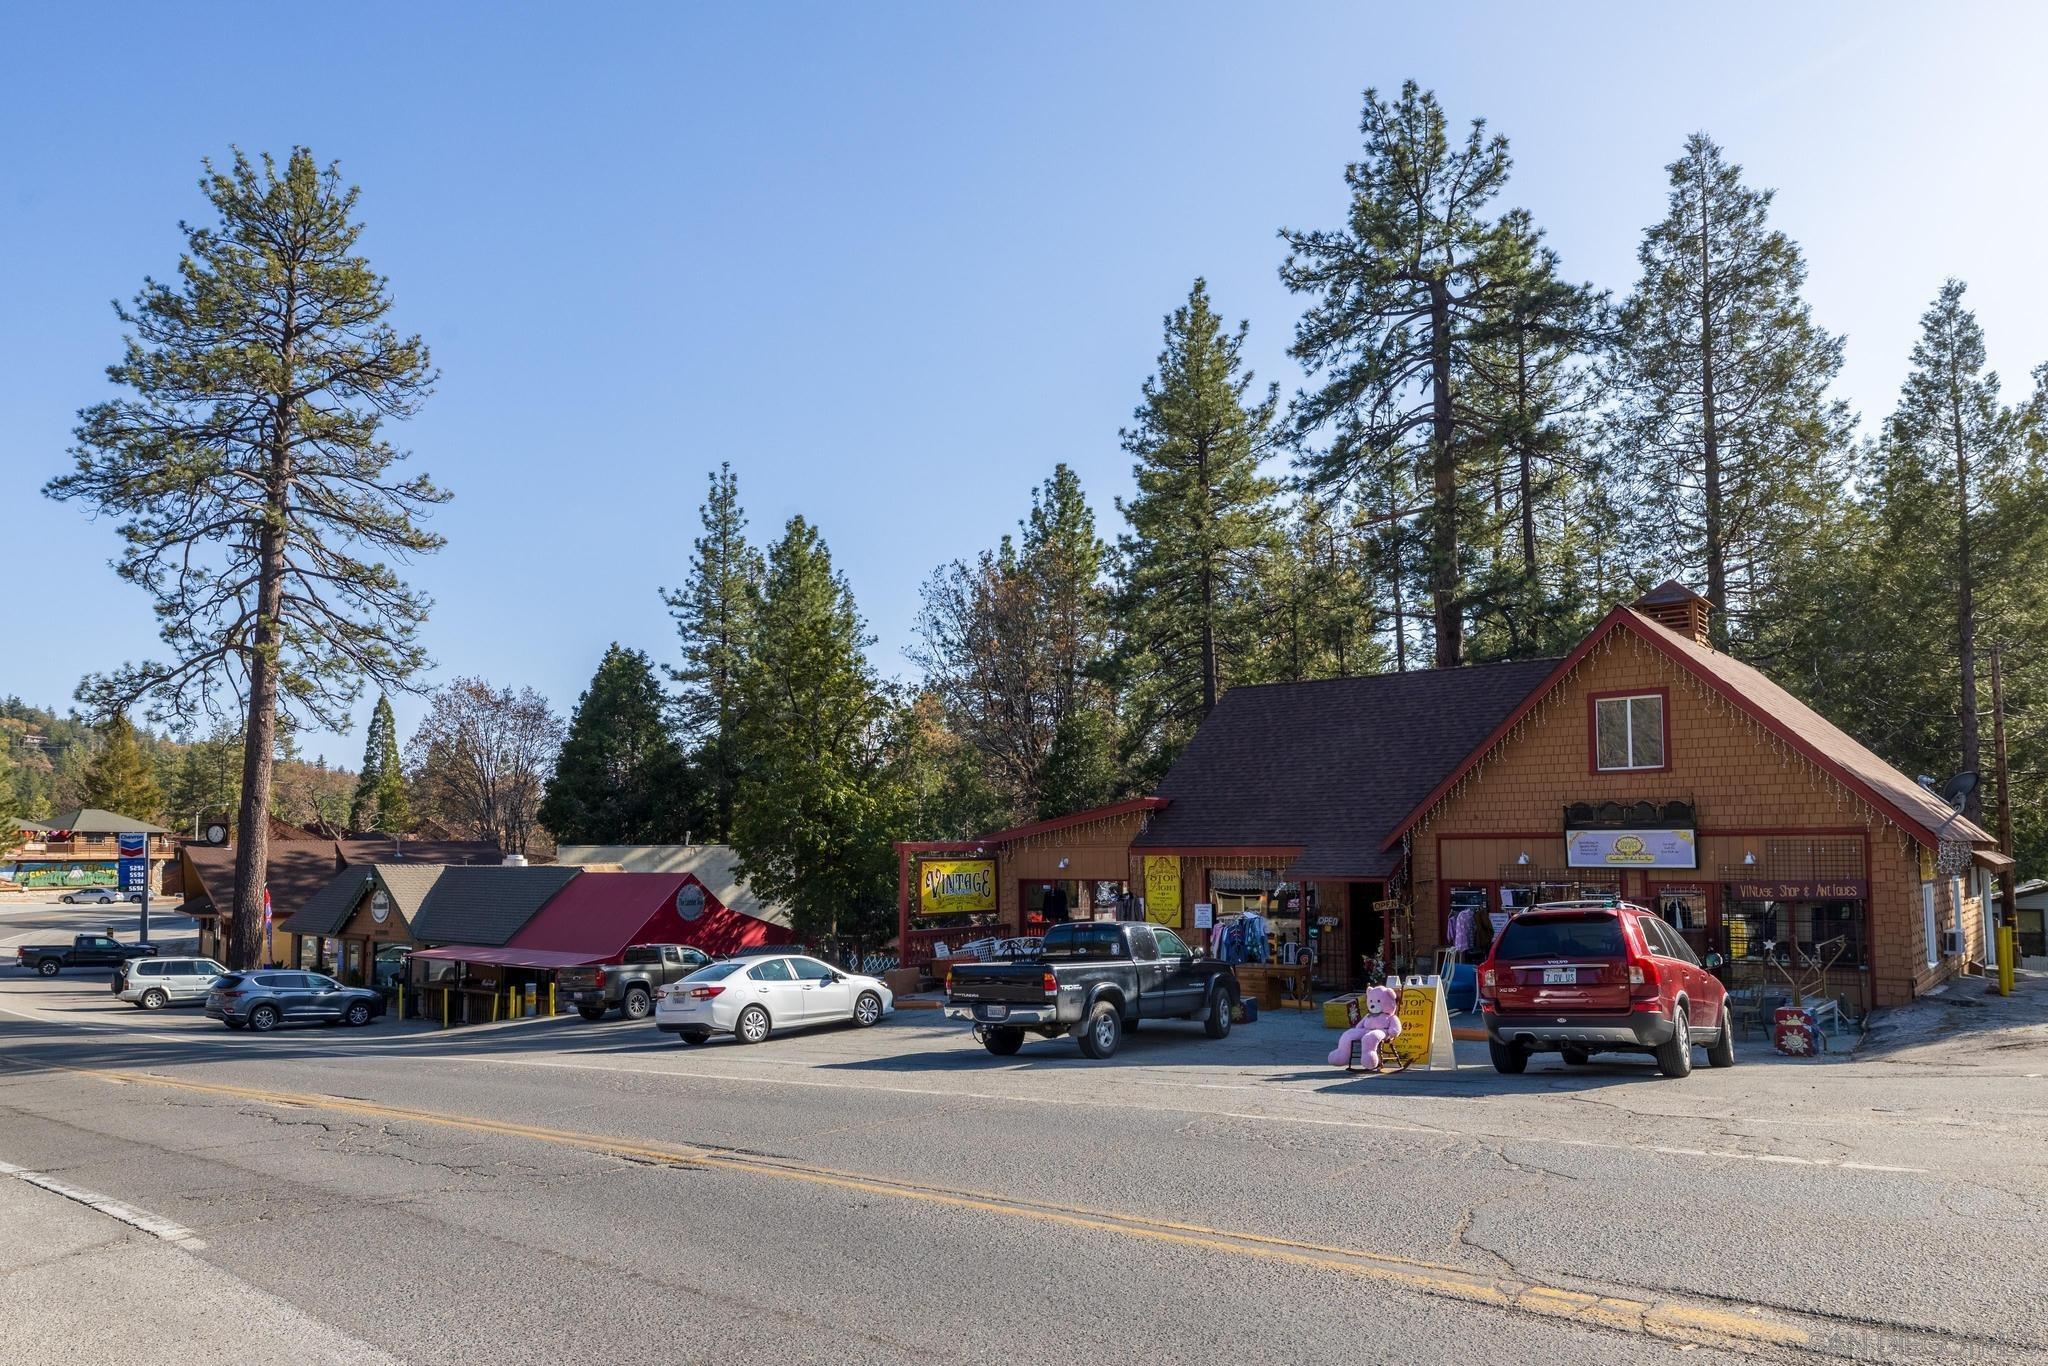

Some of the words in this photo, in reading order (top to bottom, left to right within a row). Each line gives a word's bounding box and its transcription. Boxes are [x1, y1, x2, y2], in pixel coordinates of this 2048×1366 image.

[926, 868, 991, 898] VINTAGE
[1150, 875, 1176, 883] STOP
[1375, 902, 1397, 910] OPEN
[1317, 916, 1339, 926] OPEN
